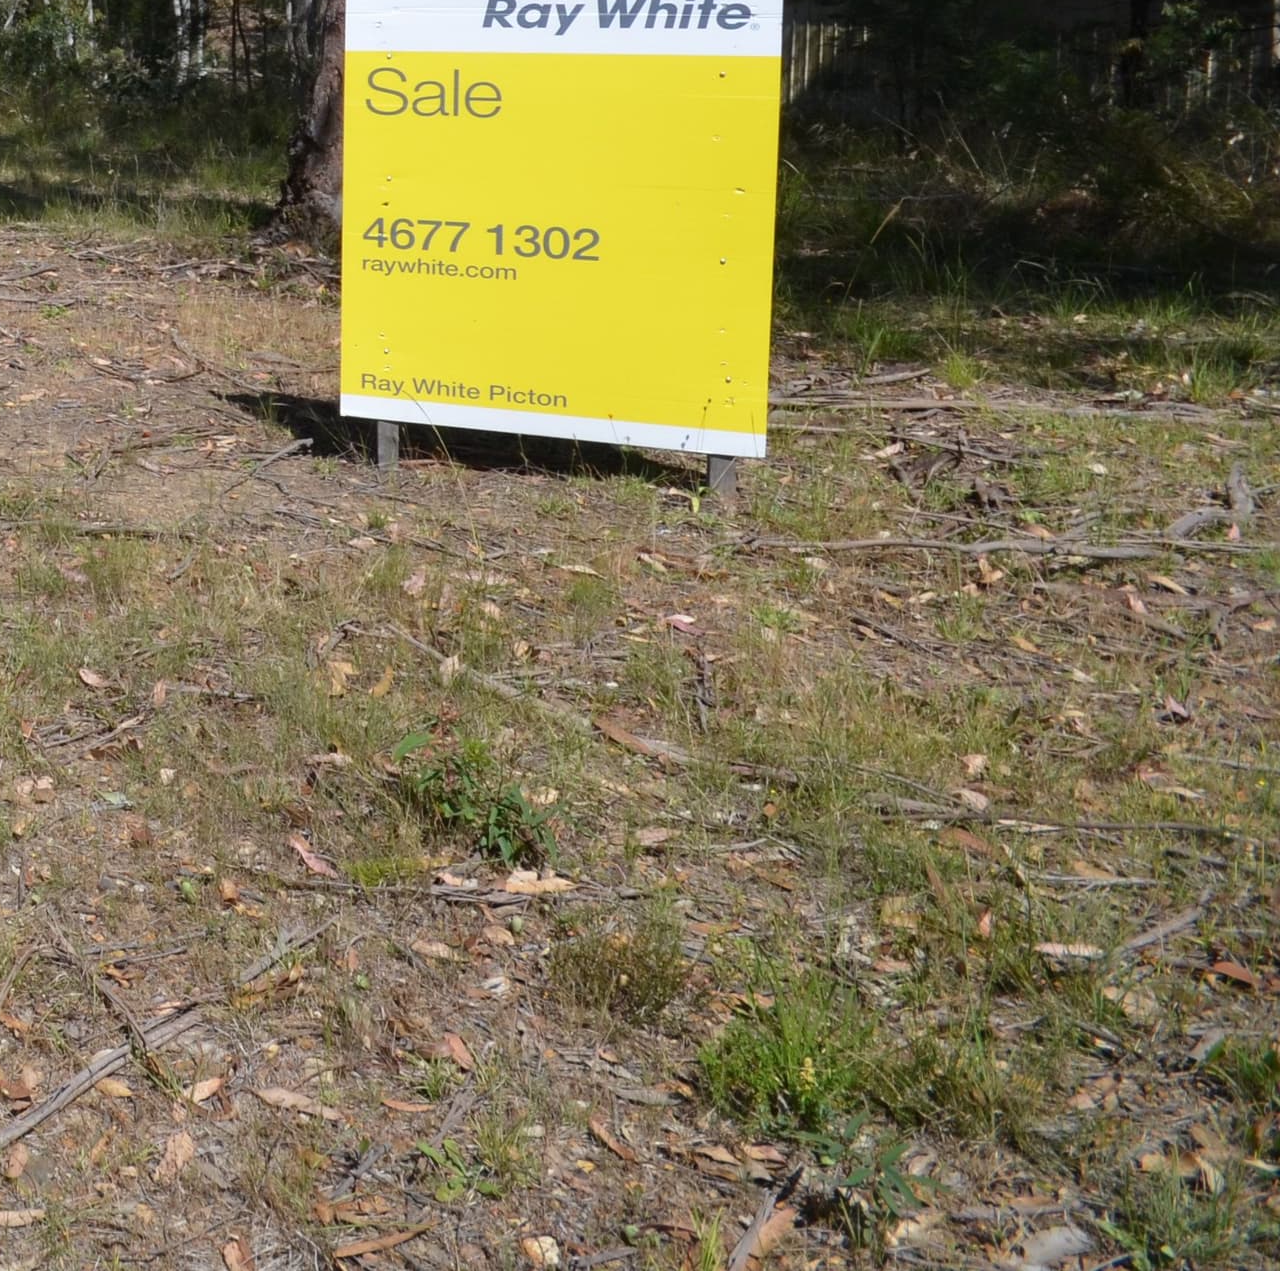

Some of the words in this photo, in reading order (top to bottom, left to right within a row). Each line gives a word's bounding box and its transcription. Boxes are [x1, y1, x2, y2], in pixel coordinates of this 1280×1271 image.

[365, 67, 503, 119] Sale
[363, 217, 470, 252] 4677
[487, 224, 600, 261] 1302
[361, 258, 517, 281] raywhite.com
[360, 373, 405, 396] Ray
[412, 377, 480, 400] White
[489, 385, 568, 408] Picton
